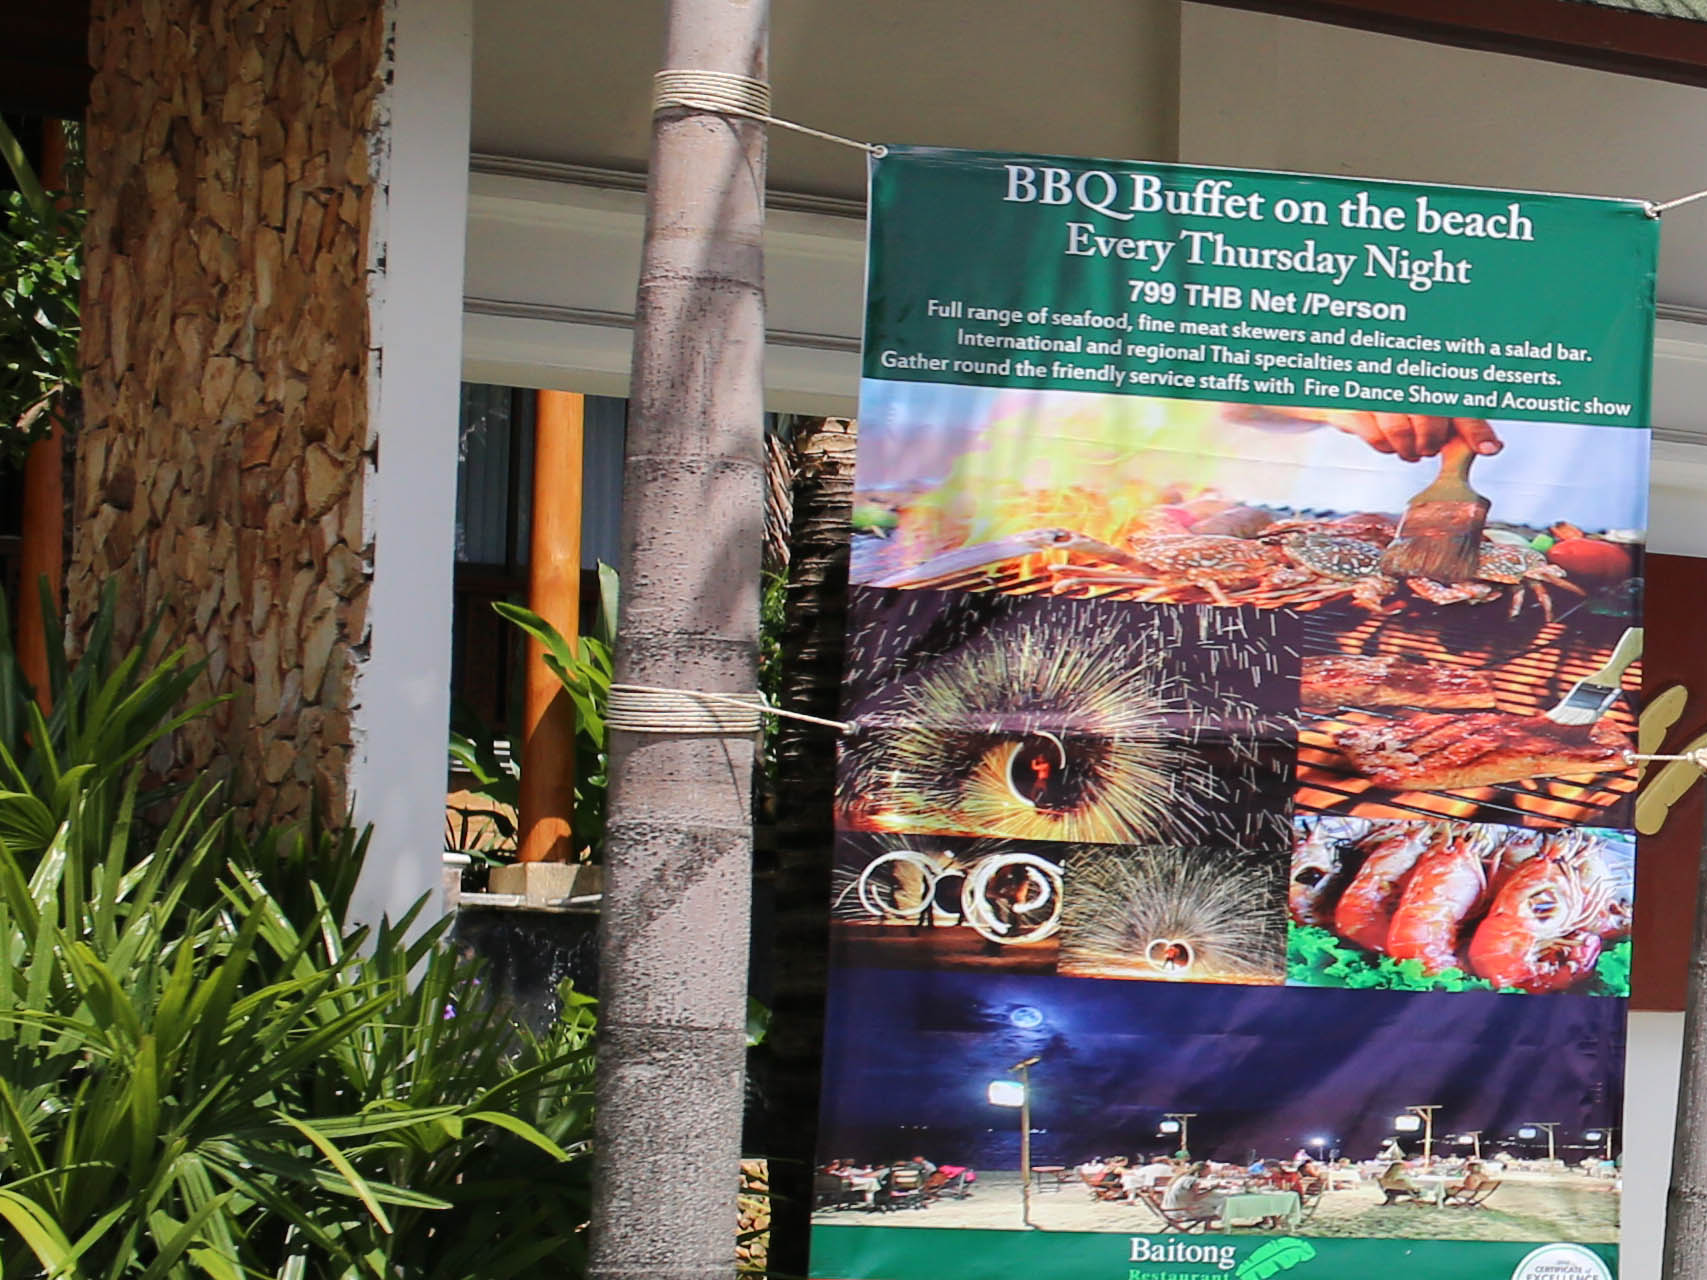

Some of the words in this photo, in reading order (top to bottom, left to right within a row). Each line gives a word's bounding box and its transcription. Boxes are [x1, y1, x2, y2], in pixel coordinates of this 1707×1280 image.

[1003, 164, 1133, 221] BBQ
[1130, 173, 1265, 220] Buffet
[1274, 199, 1329, 225] on
[1339, 191, 1405, 231] the
[1415, 196, 1534, 241] beach
[1065, 222, 1175, 272] Every
[1179, 229, 1358, 285] Thursday
[1364, 244, 1472, 291] Night
[1128, 280, 1176, 304] 799
[1183, 284, 1242, 309] THB
[1250, 288, 1297, 313] Net
[928, 299, 962, 318] Full
[968, 308, 1023, 327] range
[1027, 307, 1049, 324] of
[1052, 310, 1133, 332] seafood,
[1138, 313, 1175, 333] fine
[1180, 322, 1228, 337] meat
[1231, 321, 1306, 342] skewers
[1310, 328, 1345, 345] and
[1349, 329, 1441, 351] delicacies
[1445, 337, 1485, 354] with
[1489, 343, 1501, 356] a
[1505, 340, 1552, 359] salad
[1557, 343, 1592, 362] bar.
[959, 329, 1082, 353] International
[1086, 339, 1122, 355] and
[1127, 343, 1206, 363] regional
[1210, 345, 1250, 365] Thai
[1254, 352, 1353, 372] specialties
[1356, 357, 1392, 374] and
[1396, 358, 1479, 380] delicious
[1483, 364, 1561, 385] desserts.
[881, 350, 949, 370] Gather
[954, 359, 1010, 375] round
[1015, 359, 1047, 378] the
[1052, 361, 1126, 387] friendly
[1129, 370, 1196, 388] service
[1199, 373, 1250, 391] staffs
[1253, 377, 1295, 394] with
[1304, 378, 1340, 397] Fire
[1345, 380, 1404, 402] Dance
[1408, 385, 1459, 404] Show
[1462, 390, 1498, 407] and
[1501, 391, 1580, 413] Acoustic
[1584, 397, 1631, 416] show
[1129, 1237, 1236, 1270] Baitong
